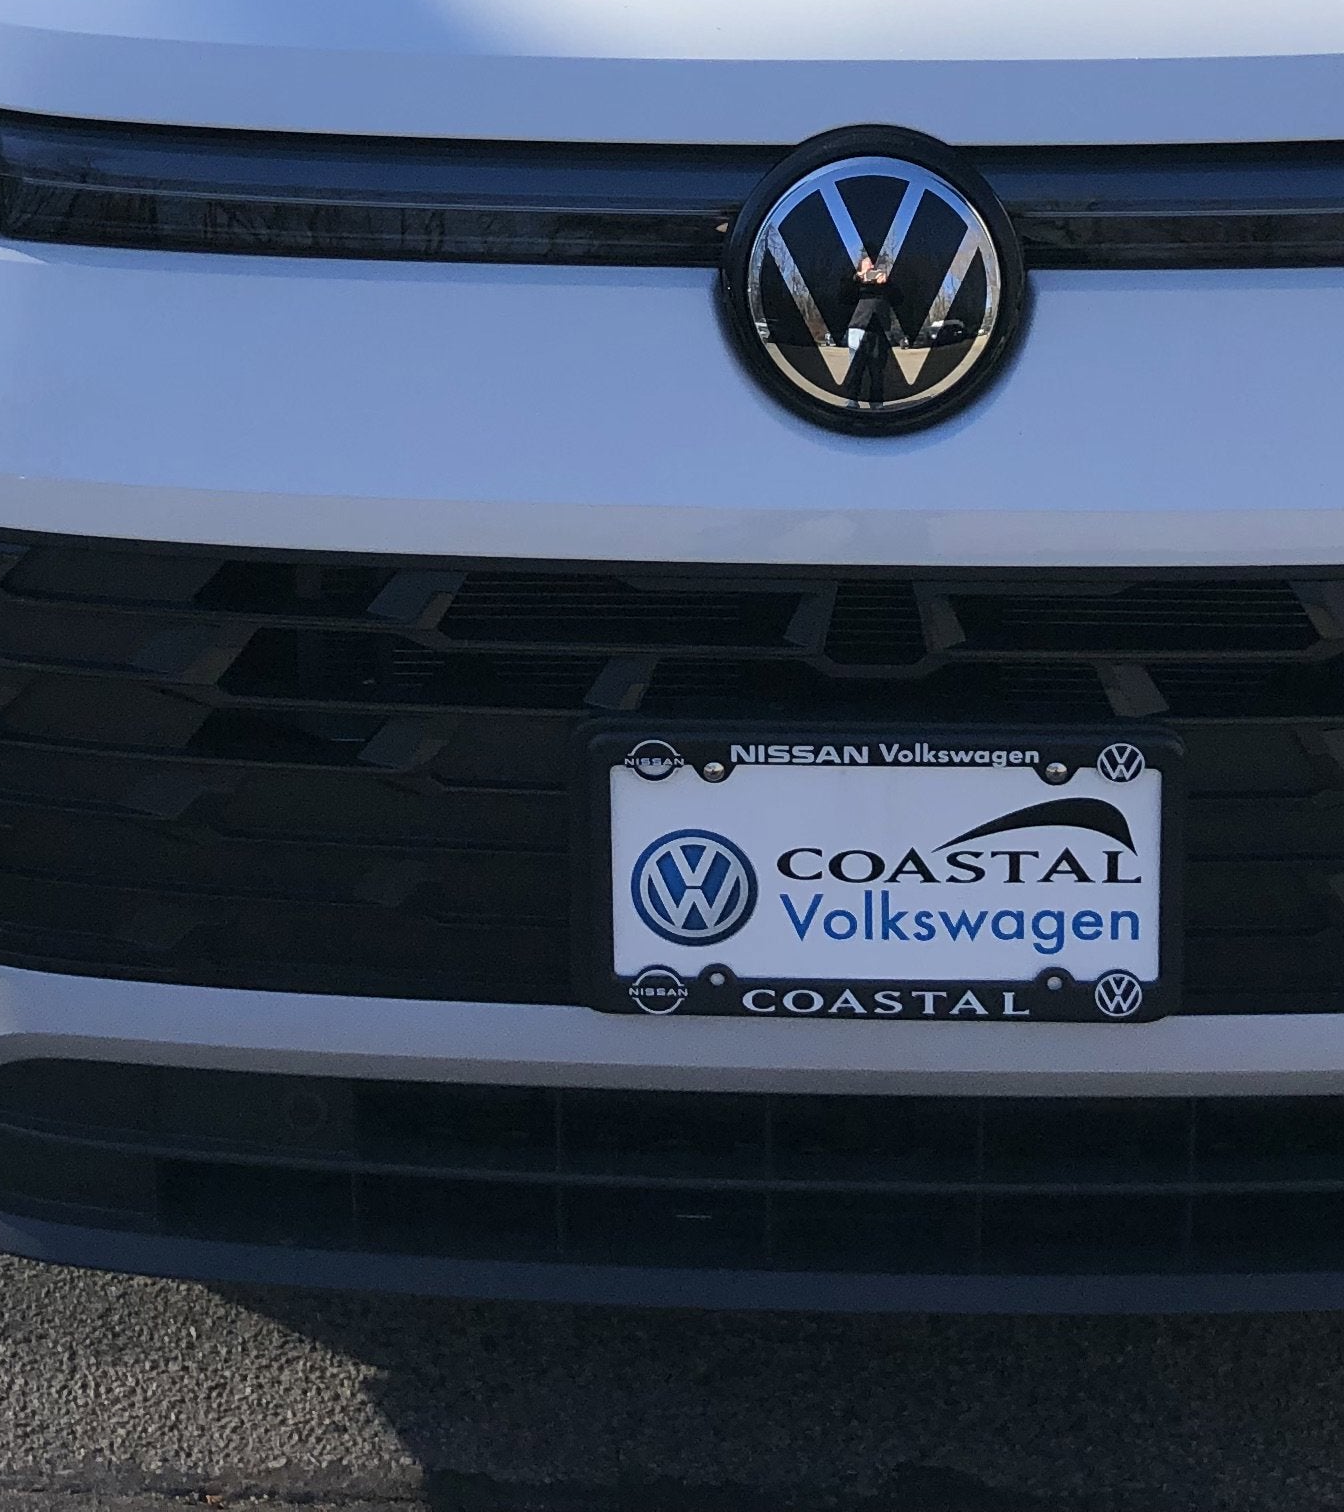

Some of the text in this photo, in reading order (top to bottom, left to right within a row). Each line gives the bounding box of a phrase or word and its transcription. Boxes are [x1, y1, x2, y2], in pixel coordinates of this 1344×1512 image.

[624, 757, 685, 766] NISSAN
[730, 742, 1040, 768] NISSAN Volkswagen
[776, 847, 1142, 884] COASTAL
[779, 890, 1141, 954] Volkswagen
[628, 987, 689, 997] NISSAN
[742, 988, 1030, 1016] COASTAL
